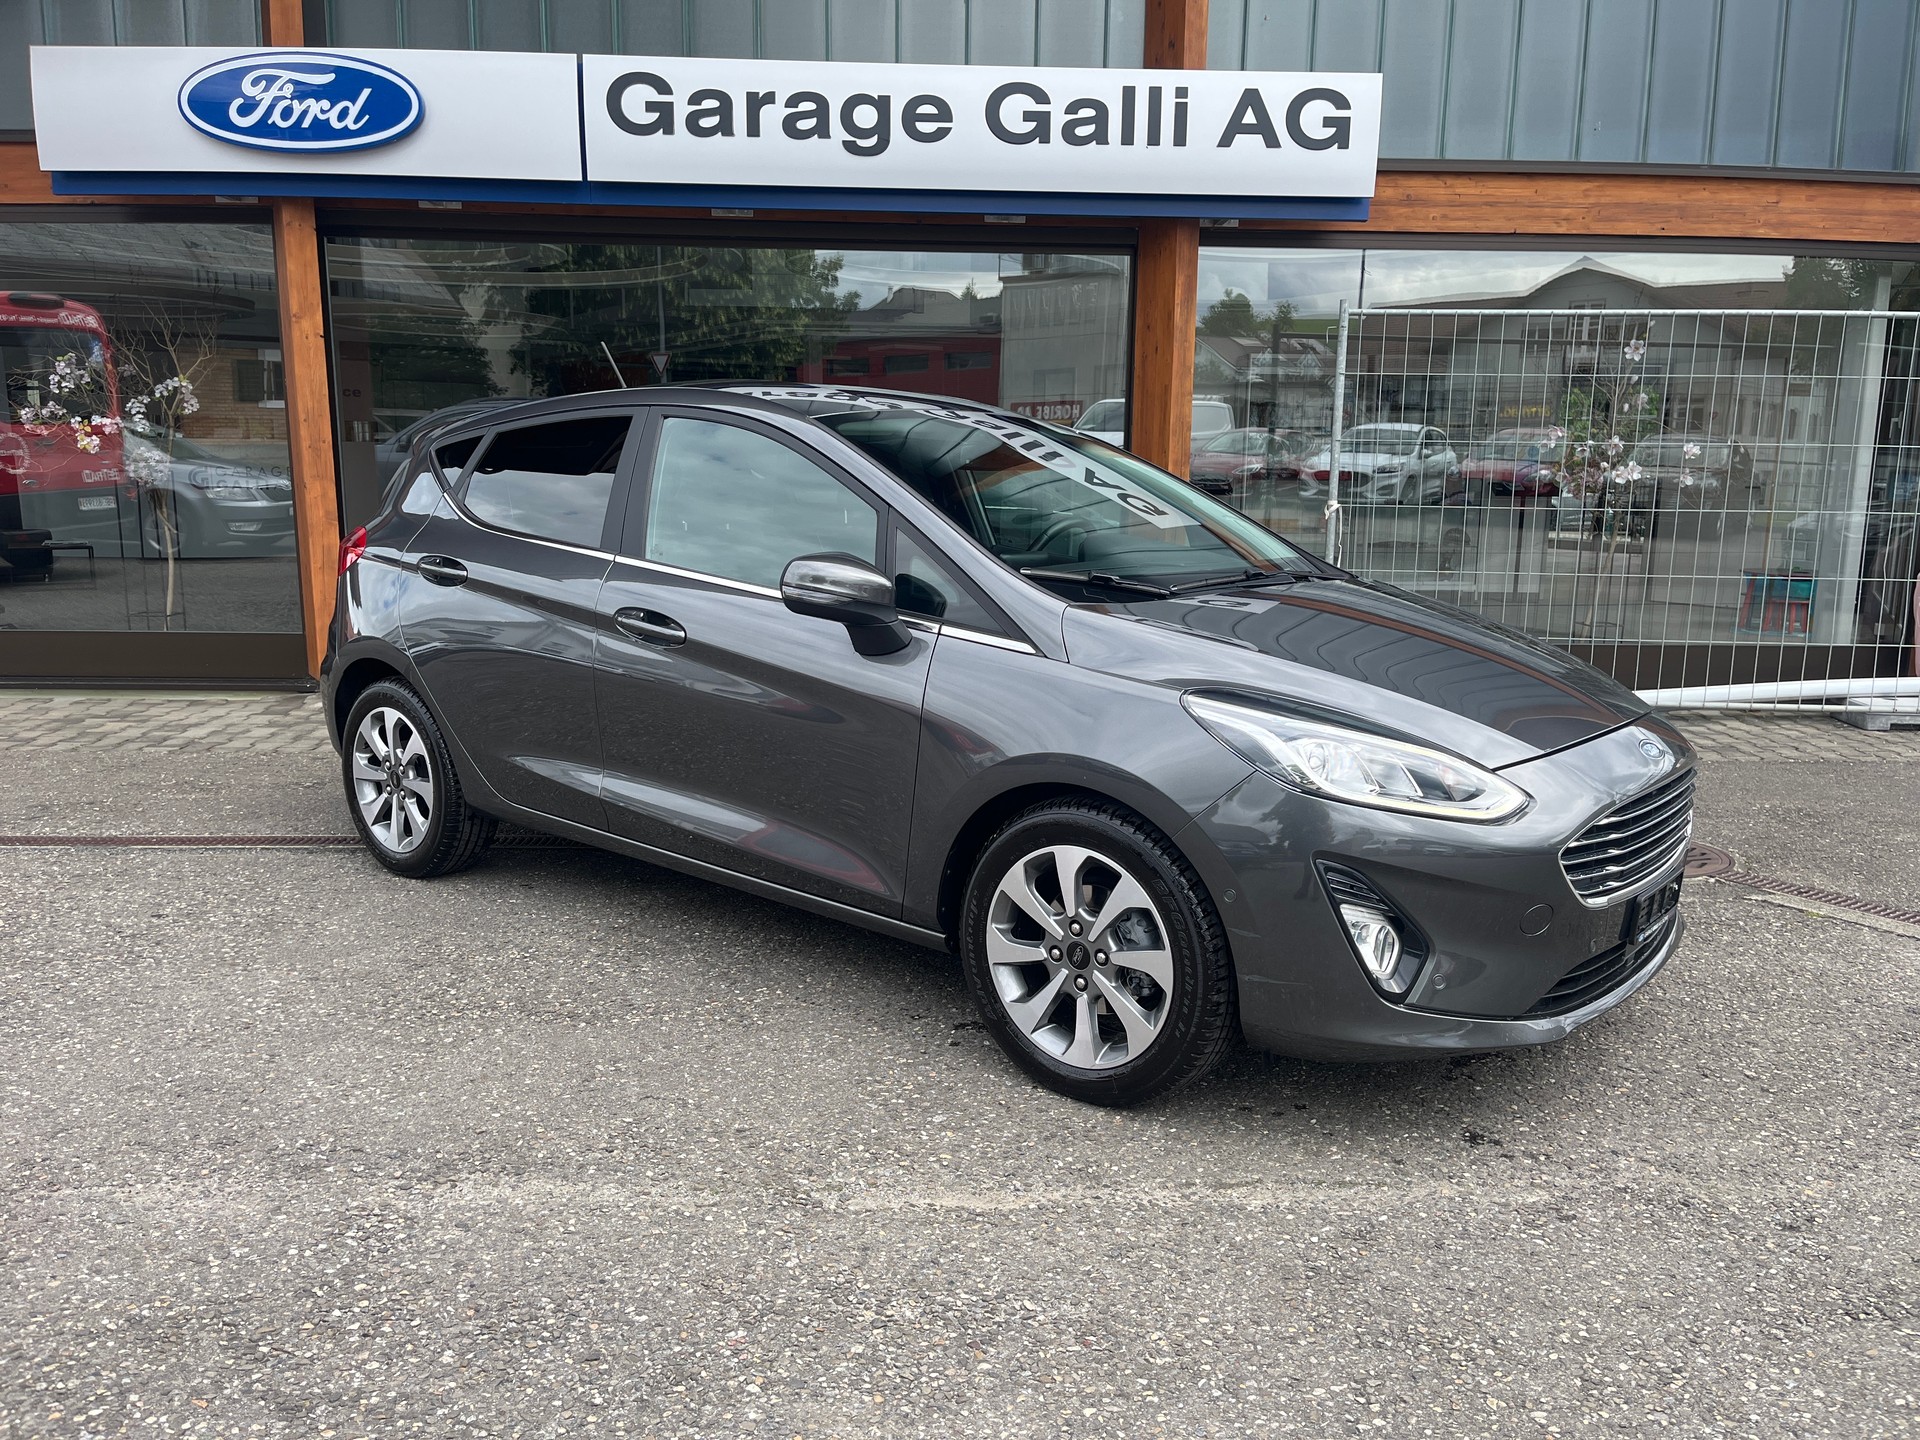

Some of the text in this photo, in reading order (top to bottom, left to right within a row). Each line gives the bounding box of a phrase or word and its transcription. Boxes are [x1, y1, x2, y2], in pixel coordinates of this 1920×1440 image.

[229, 69, 372, 130] Ford
[606, 71, 1352, 156] Garage Galli AG
